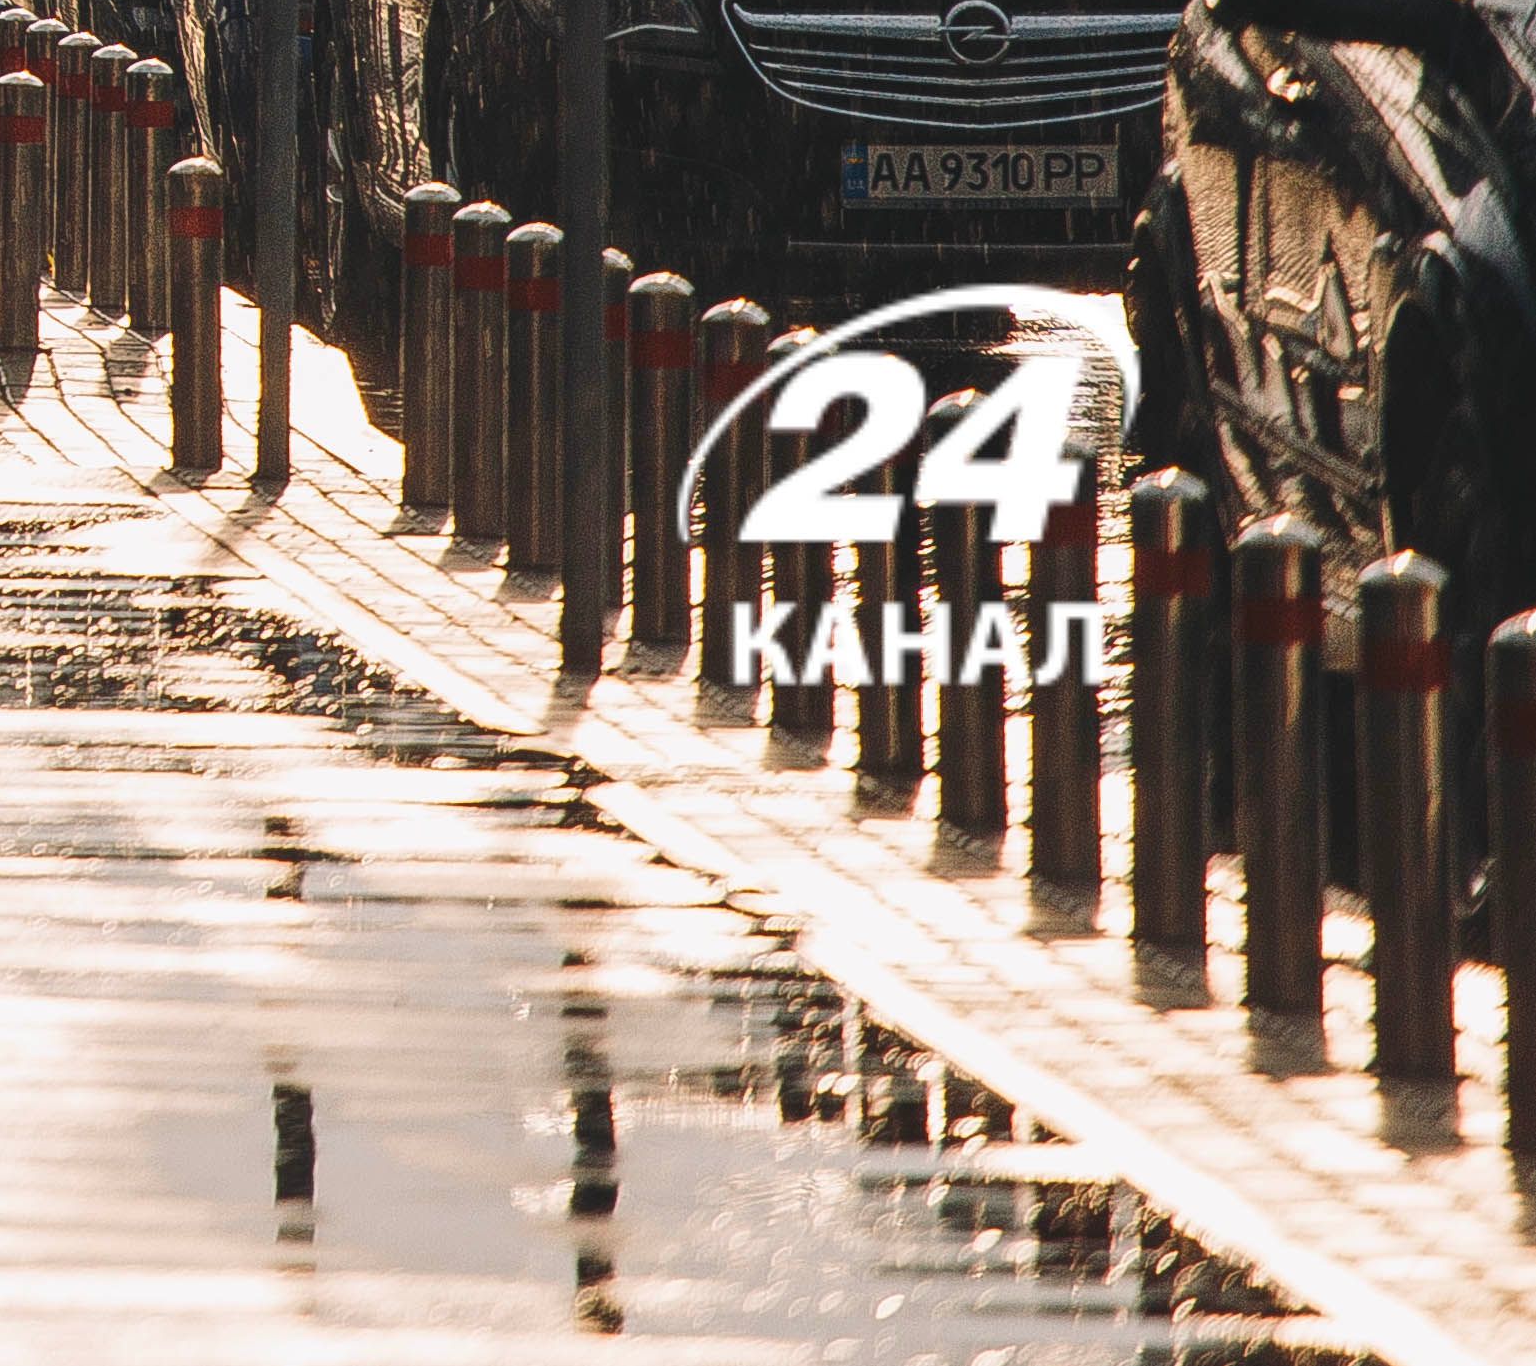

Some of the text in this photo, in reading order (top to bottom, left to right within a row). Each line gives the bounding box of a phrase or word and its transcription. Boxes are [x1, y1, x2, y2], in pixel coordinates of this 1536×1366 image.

[871, 152, 1105, 191] AA 9310 PP
